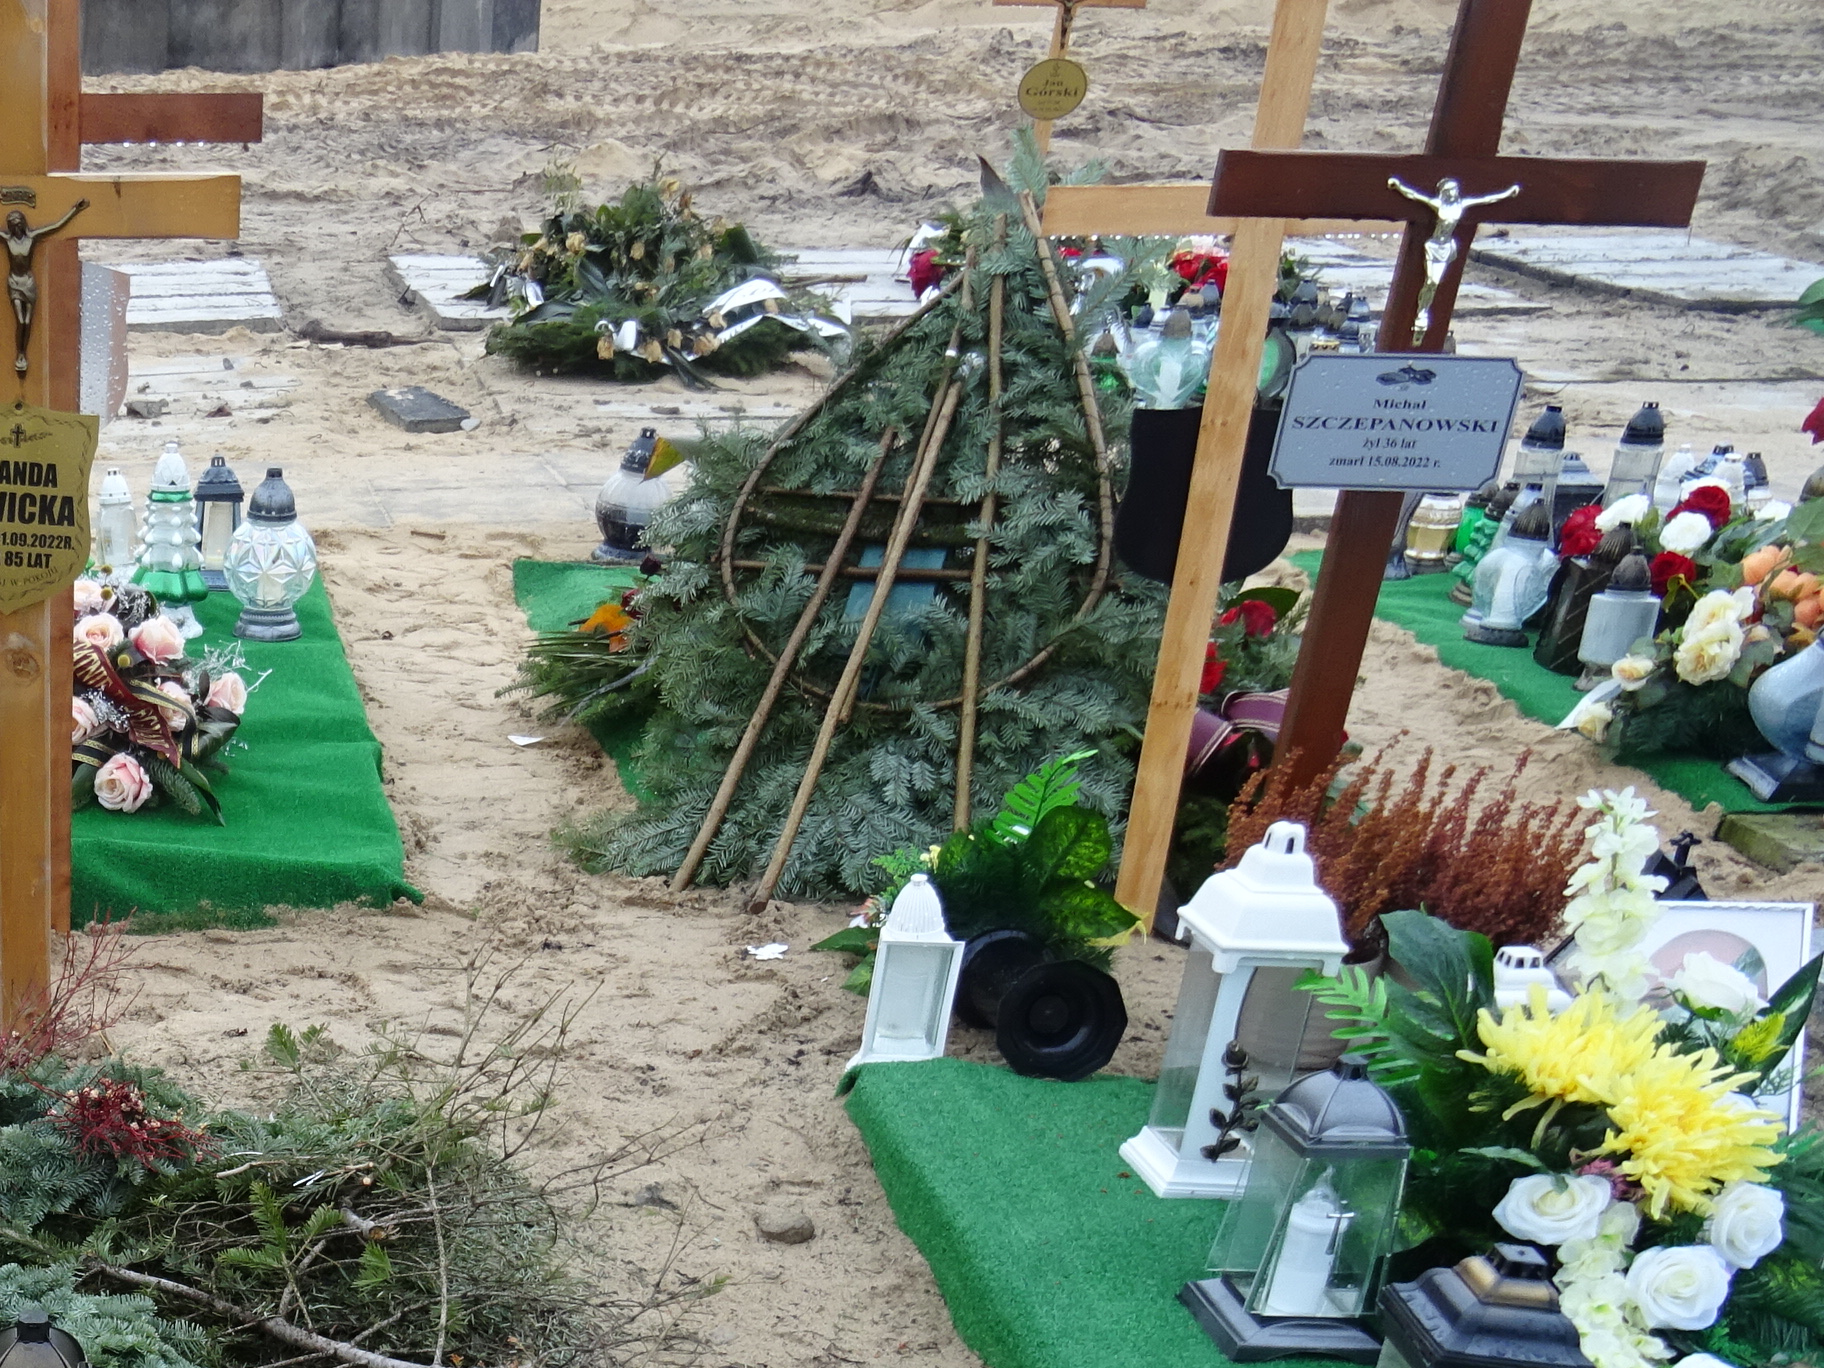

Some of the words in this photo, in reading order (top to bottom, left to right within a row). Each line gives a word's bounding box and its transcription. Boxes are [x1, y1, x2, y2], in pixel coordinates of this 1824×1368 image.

[1291, 415, 1500, 433] SZCZEPANOWSKI
[1383, 437, 1397, 449] 36
[1400, 437, 1418, 449] lat
[1367, 456, 1430, 469] 15.08.2022
[4, 550, 23, 568] 85
[26, 552, 52, 569] LAT
[23, 565, 58, 585] POKOJU
